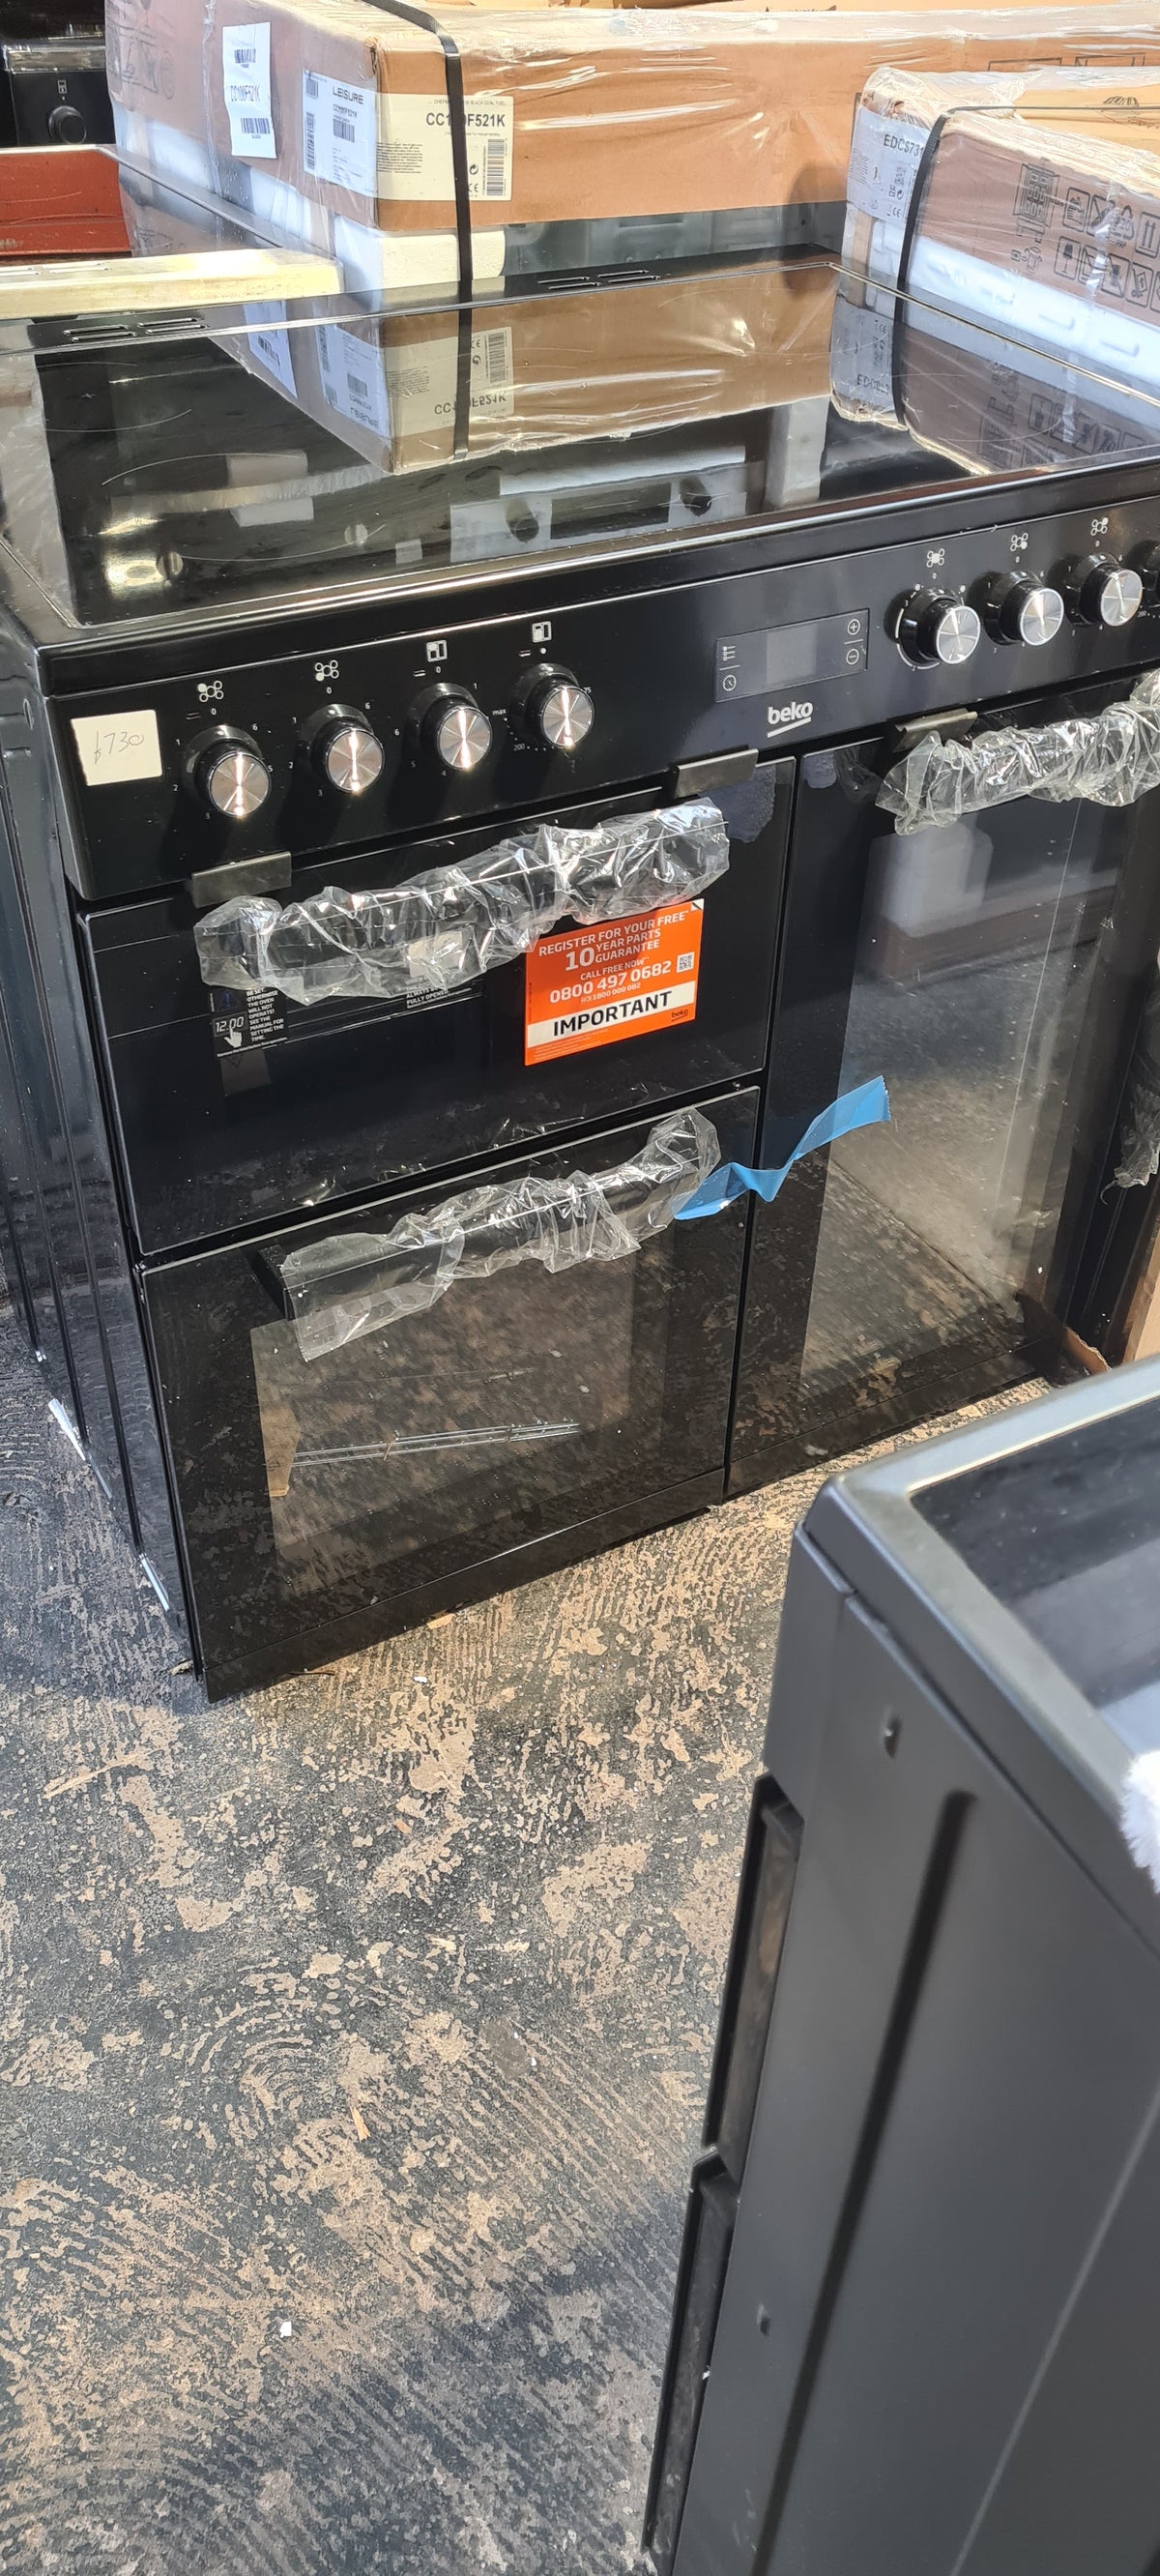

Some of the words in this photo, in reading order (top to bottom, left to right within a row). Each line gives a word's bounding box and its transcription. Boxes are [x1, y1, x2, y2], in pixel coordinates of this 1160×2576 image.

[333, 85, 364, 105] LEISURE
[425, 112, 506, 127] CC1F521K
[767, 701, 814, 725] beko
[538, 934, 595, 956] REGISTER
[598, 928, 622, 942] FOR
[624, 920, 655, 934] YOUR
[566, 947, 594, 971] 10
[595, 938, 624, 952] YEAR
[626, 928, 661, 945] PARTS
[594, 939, 660, 963] GUARANTEE
[580, 971, 601, 981] CALL
[602, 964, 624, 976] FREE
[549, 981, 594, 1004] 0800
[596, 973, 627, 991] 497
[630, 960, 672, 982] 0682
[246, 990, 278, 1003] OTHERWISE
[259, 997, 275, 1006] OVEN
[406, 995, 425, 1006] FULLY
[593, 989, 611, 1001] 1800
[612, 986, 626, 995] 000
[553, 991, 672, 1037] IMPORTANT
[671, 1009, 689, 1019] beko
[216, 1016, 245, 1033] 12.00
[249, 1021, 274, 1031] MANUAL
[250, 1028, 274, 1037] SETTING
